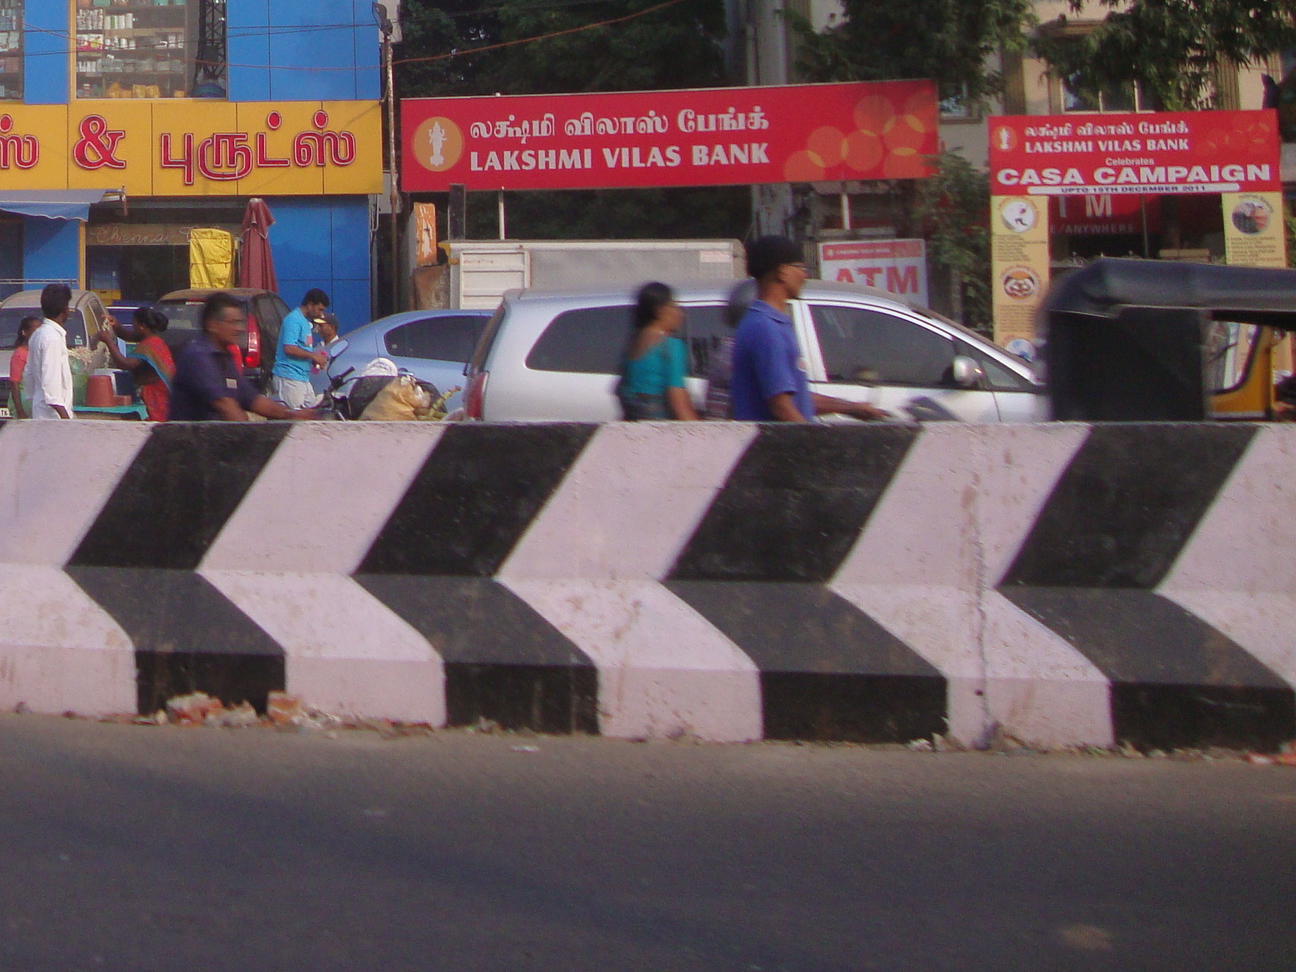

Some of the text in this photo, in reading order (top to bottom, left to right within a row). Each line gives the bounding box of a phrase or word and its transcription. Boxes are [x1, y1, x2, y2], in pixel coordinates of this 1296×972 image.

[470, 105, 770, 145] லக்ஷ்மி விலாஸ் பேங்க்
[1076, 121, 1134, 137] விலாஸ்
[1137, 119, 1189, 135] பேங்க்
[73, 113, 127, 171] &
[1024, 138, 1190, 154] LAKSHMI VILAS BANK
[470, 142, 770, 172] LAKSHMI VILAS BANK
[1105, 157, 1155, 167] Celebrates
[996, 163, 1271, 186] CASA CAMPAIGN
[1120, 185, 1179, 193] DECEMBER
[1181, 184, 1207, 192] 2011
[836, 265, 920, 295] ATM
